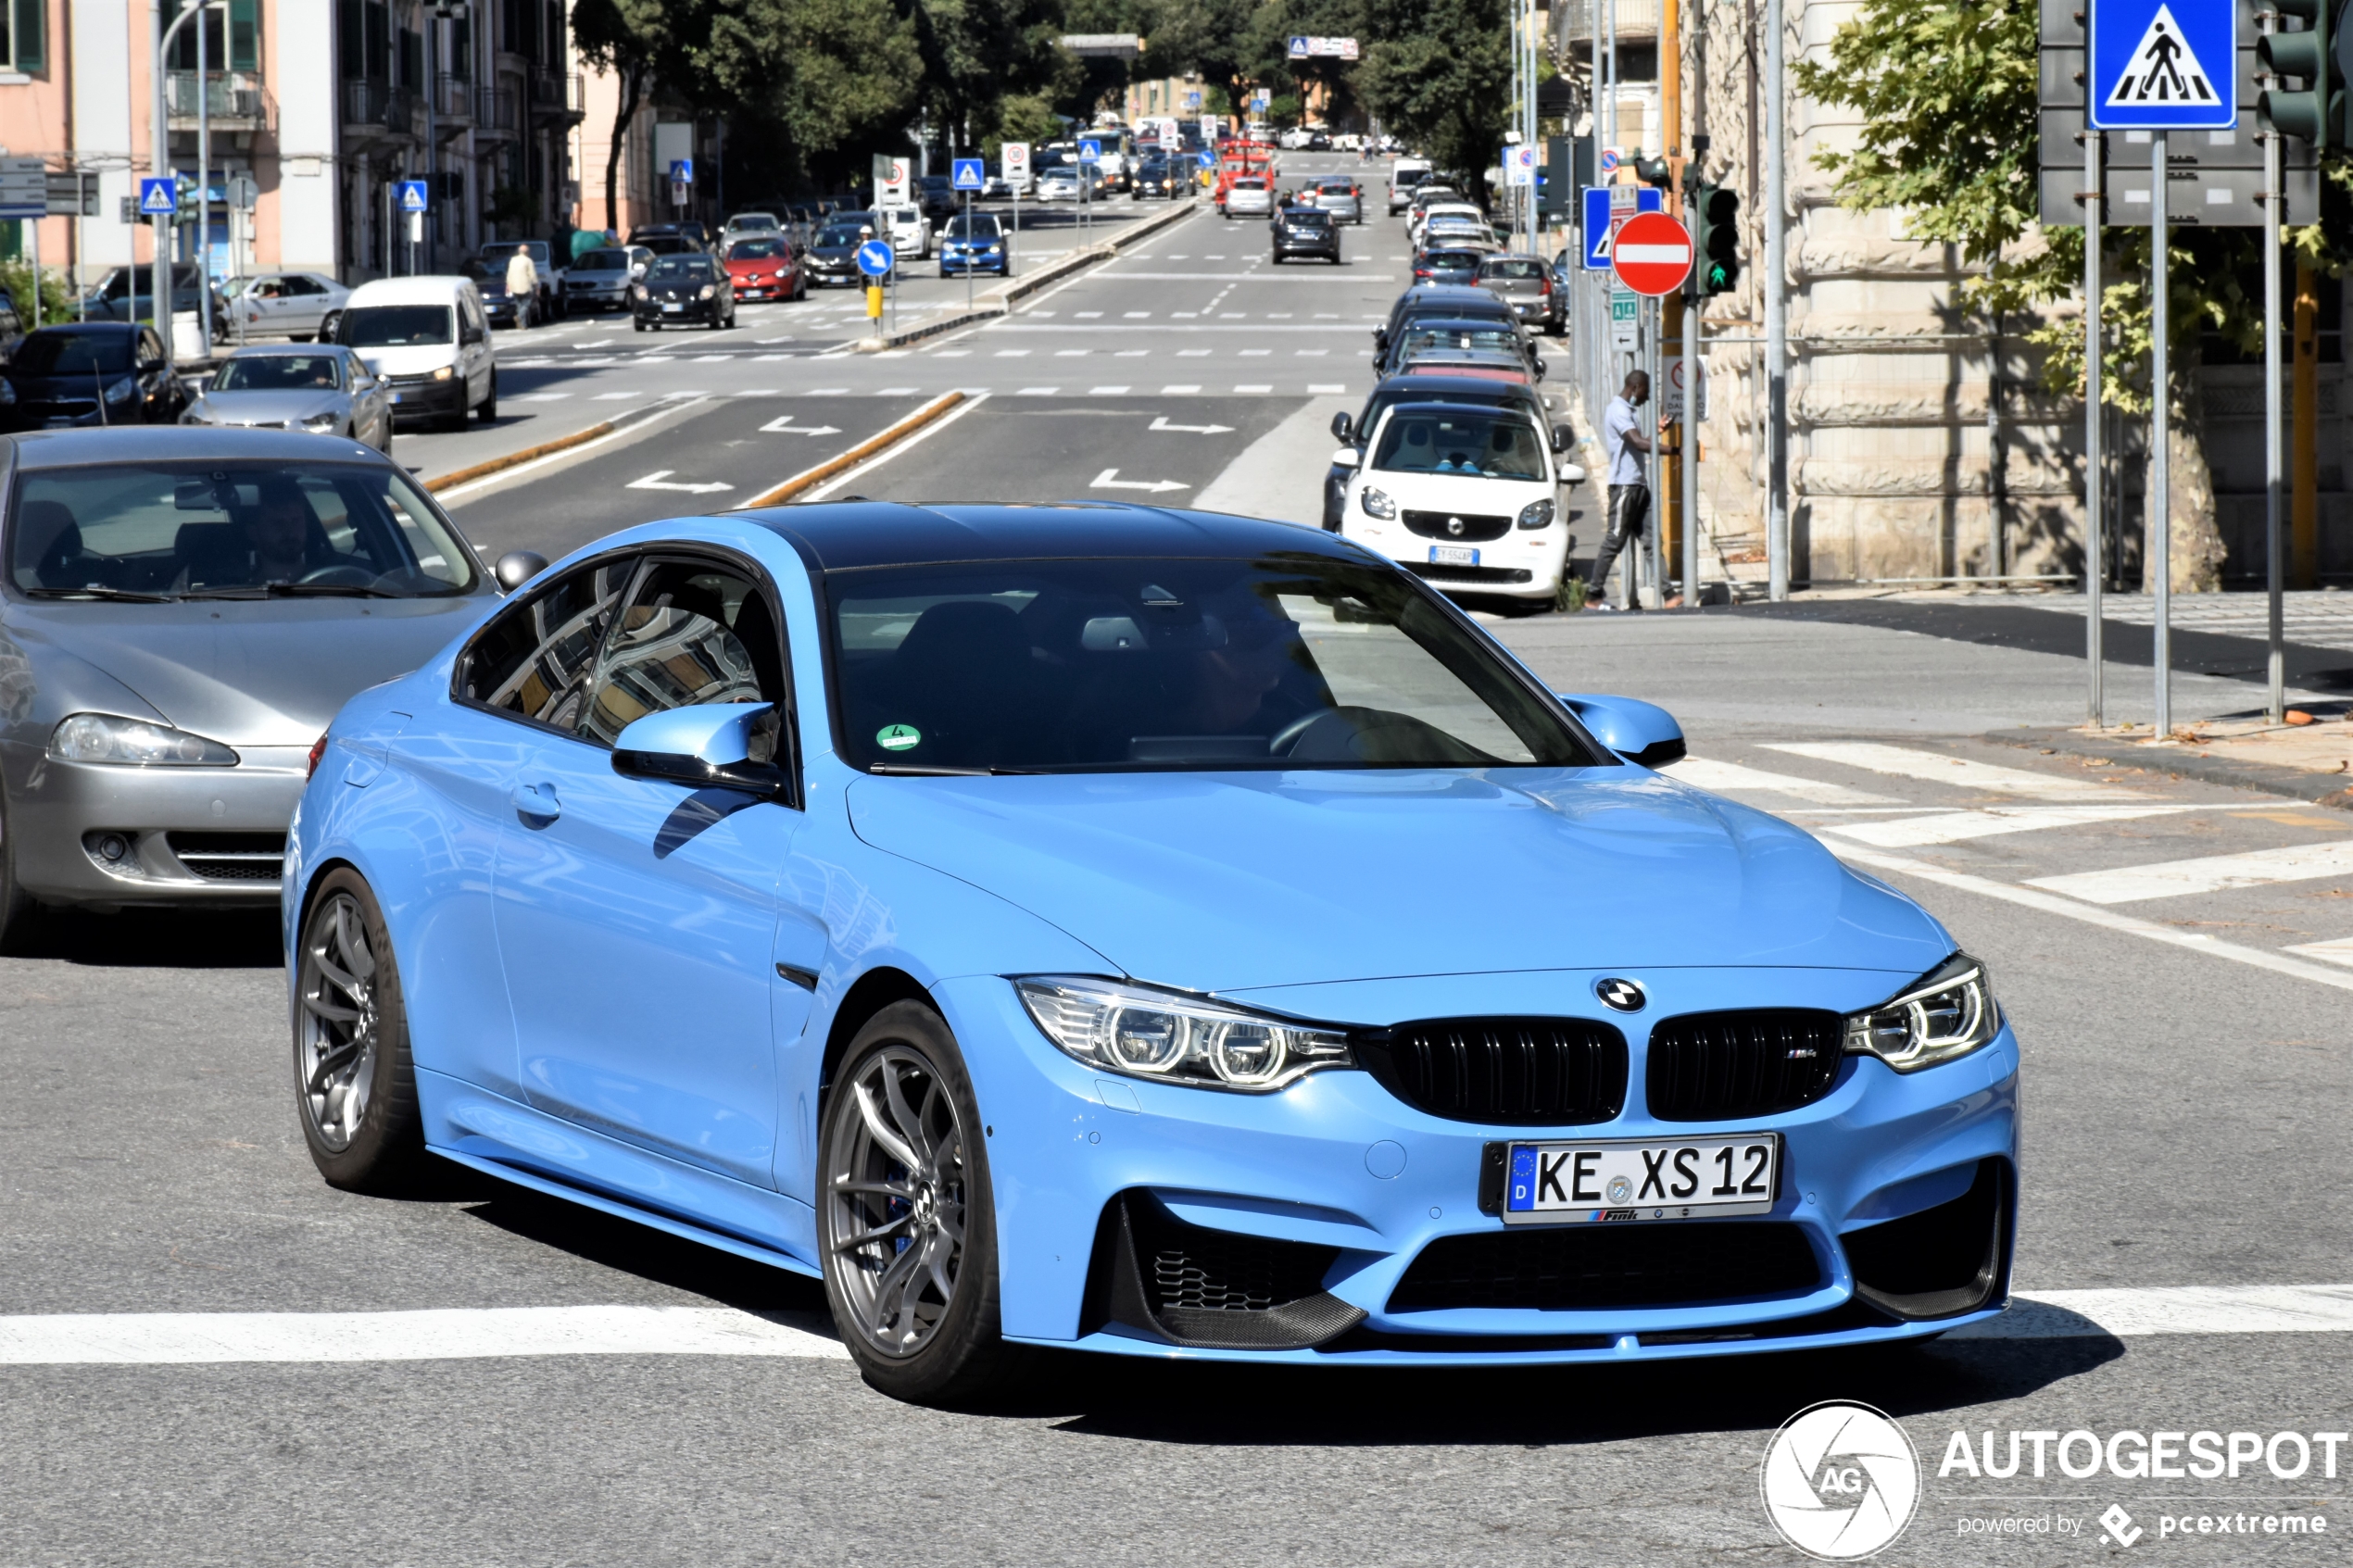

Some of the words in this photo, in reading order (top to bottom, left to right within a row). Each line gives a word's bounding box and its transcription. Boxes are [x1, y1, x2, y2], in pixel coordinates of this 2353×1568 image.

[892, 725, 904, 737] 4
[1538, 1151, 1602, 1202] KE
[1637, 1148, 1700, 1199] XS
[1712, 1145, 1768, 1196] 12
[1516, 1185, 1527, 1199] D
